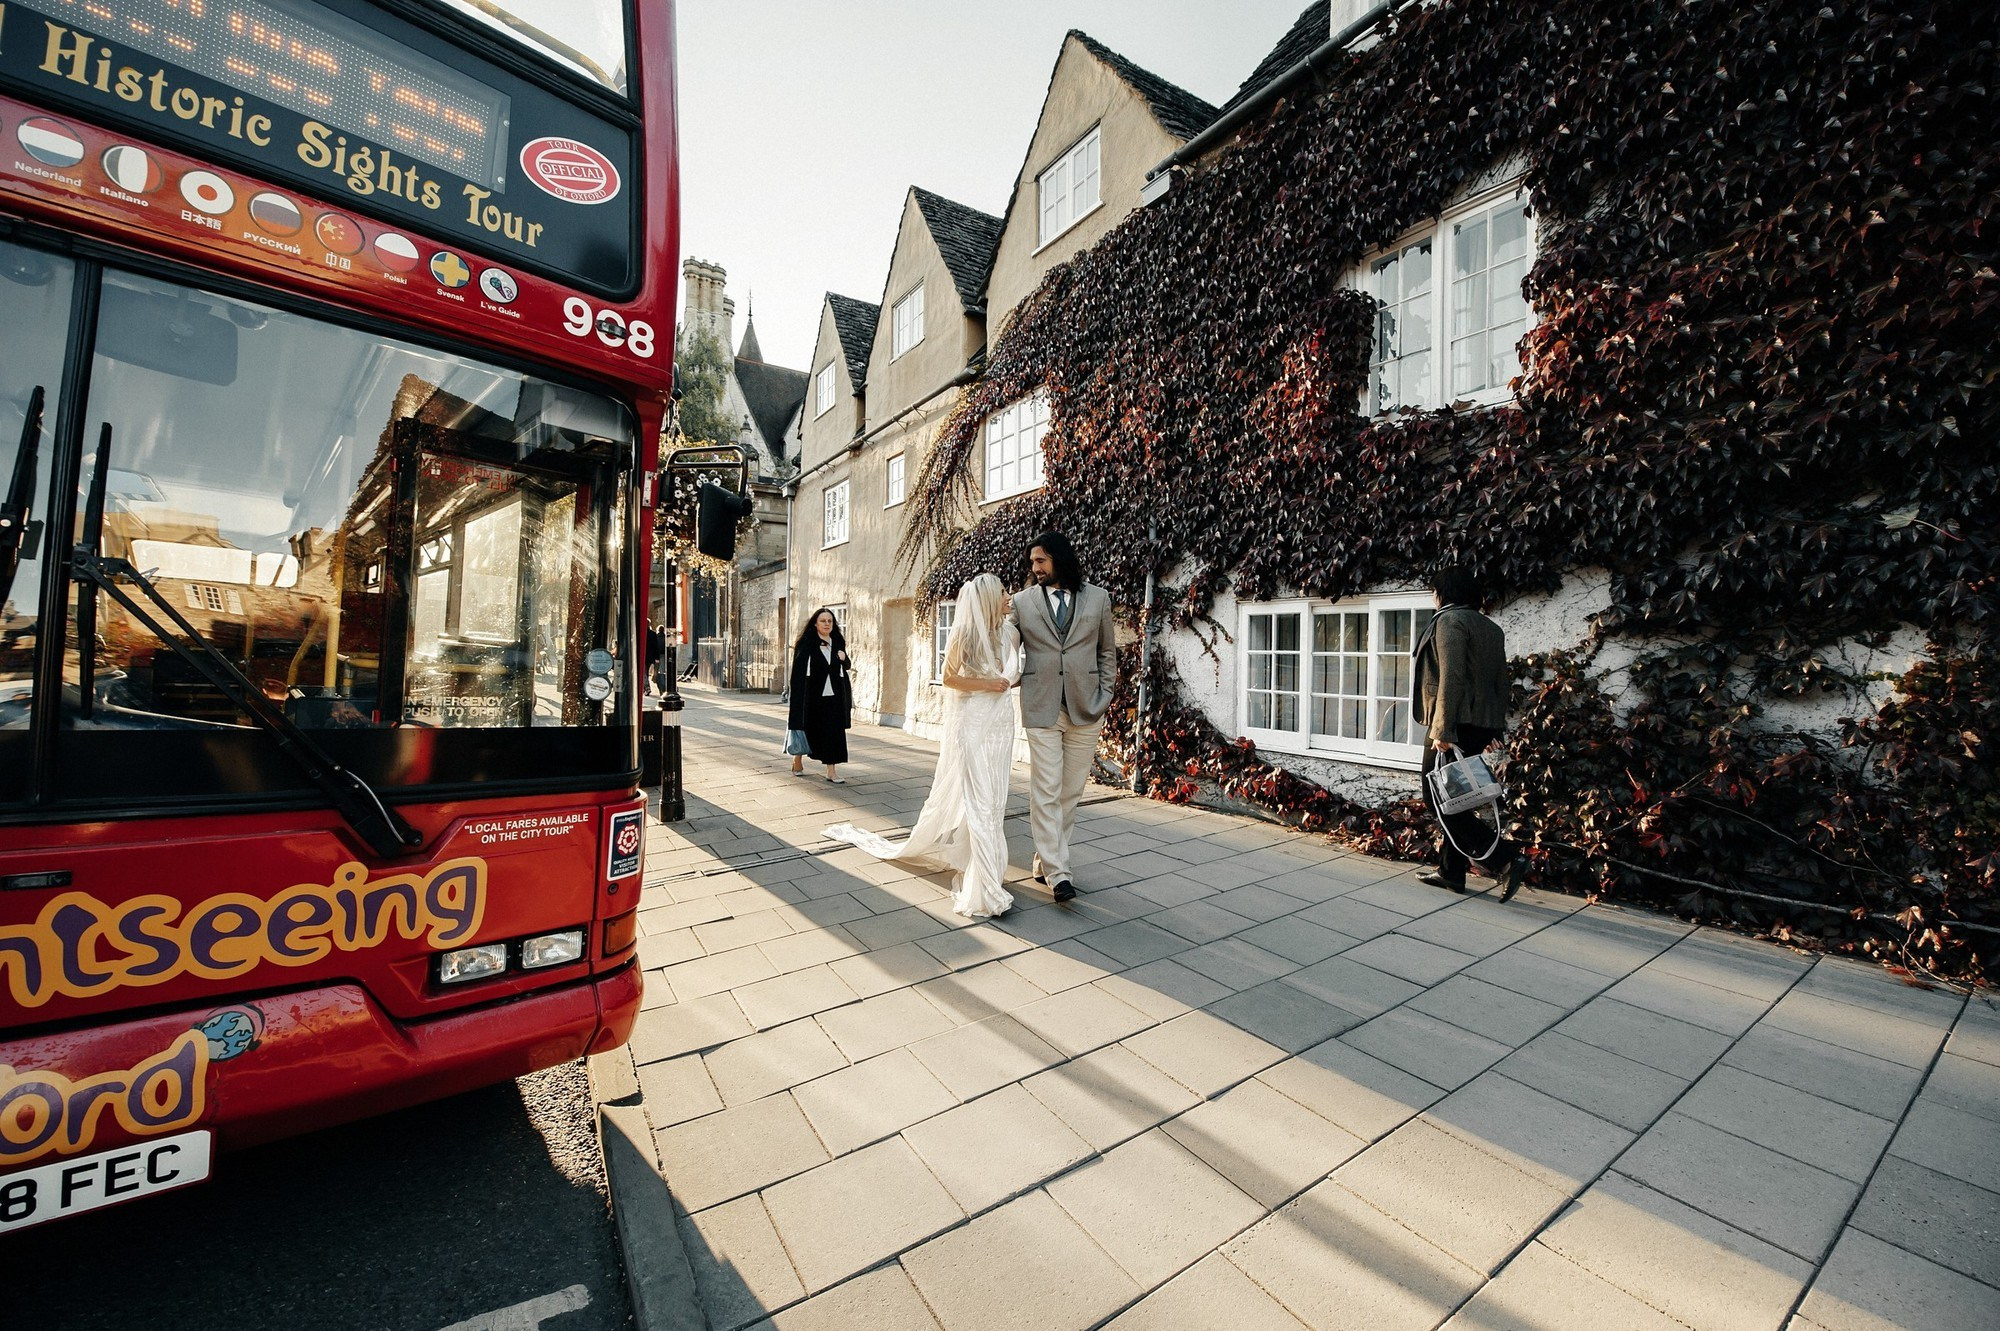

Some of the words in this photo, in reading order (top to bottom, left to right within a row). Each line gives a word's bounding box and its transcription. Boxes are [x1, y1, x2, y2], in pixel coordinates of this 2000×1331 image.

[38, 21, 273, 147] Historic
[297, 121, 442, 210] Sights
[462, 183, 544, 248] Tour
[547, 140, 579, 152] TOUR
[14, 161, 82, 187] Nederland
[540, 162, 605, 179] OFFICIAL
[100, 186, 149, 207] Italiano
[555, 187, 569, 198] OF
[570, 189, 607, 201] OXFORD
[181, 209, 222, 231] 日本語
[383, 272, 408, 285] Polski
[436, 288, 465, 302] Svensk
[498, 306, 521, 319] Guide
[562, 296, 655, 359] 908
[404, 696, 417, 706] IN
[424, 696, 504, 707] EMERGENCY
[404, 707, 438, 717] PUSH
[447, 707, 464, 717] TO
[469, 707, 503, 717] OPEN
[464, 822, 504, 835] "LOCAL
[505, 818, 538, 830] FARES
[539, 813, 589, 827] AVAILABLE
[481, 833, 497, 844] ON
[498, 831, 519, 842] THE
[520, 828, 542, 839] CITY
[543, 825, 574, 837] TOUR"
[0, 1178, 38, 1222] 8
[60, 1144, 182, 1209] FEC
